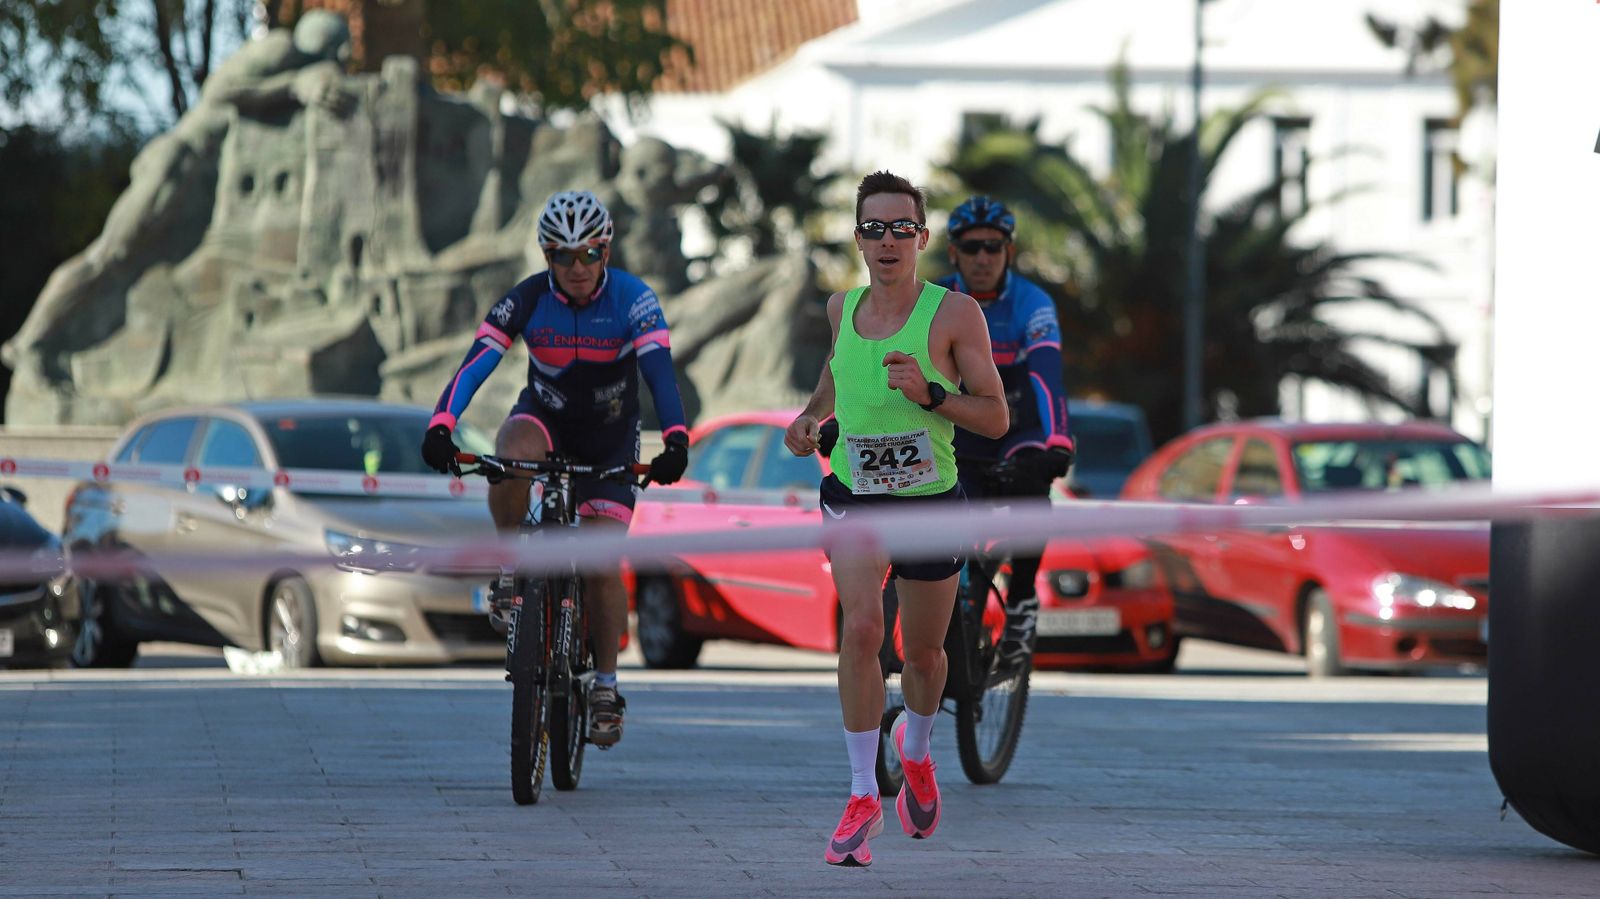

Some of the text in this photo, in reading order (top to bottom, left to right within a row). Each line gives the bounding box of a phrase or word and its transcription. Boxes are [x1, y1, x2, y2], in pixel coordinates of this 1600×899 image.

[900, 432, 925, 441] MILITAR
[887, 439, 917, 447] CIUDADES
[860, 445, 922, 471] 242
